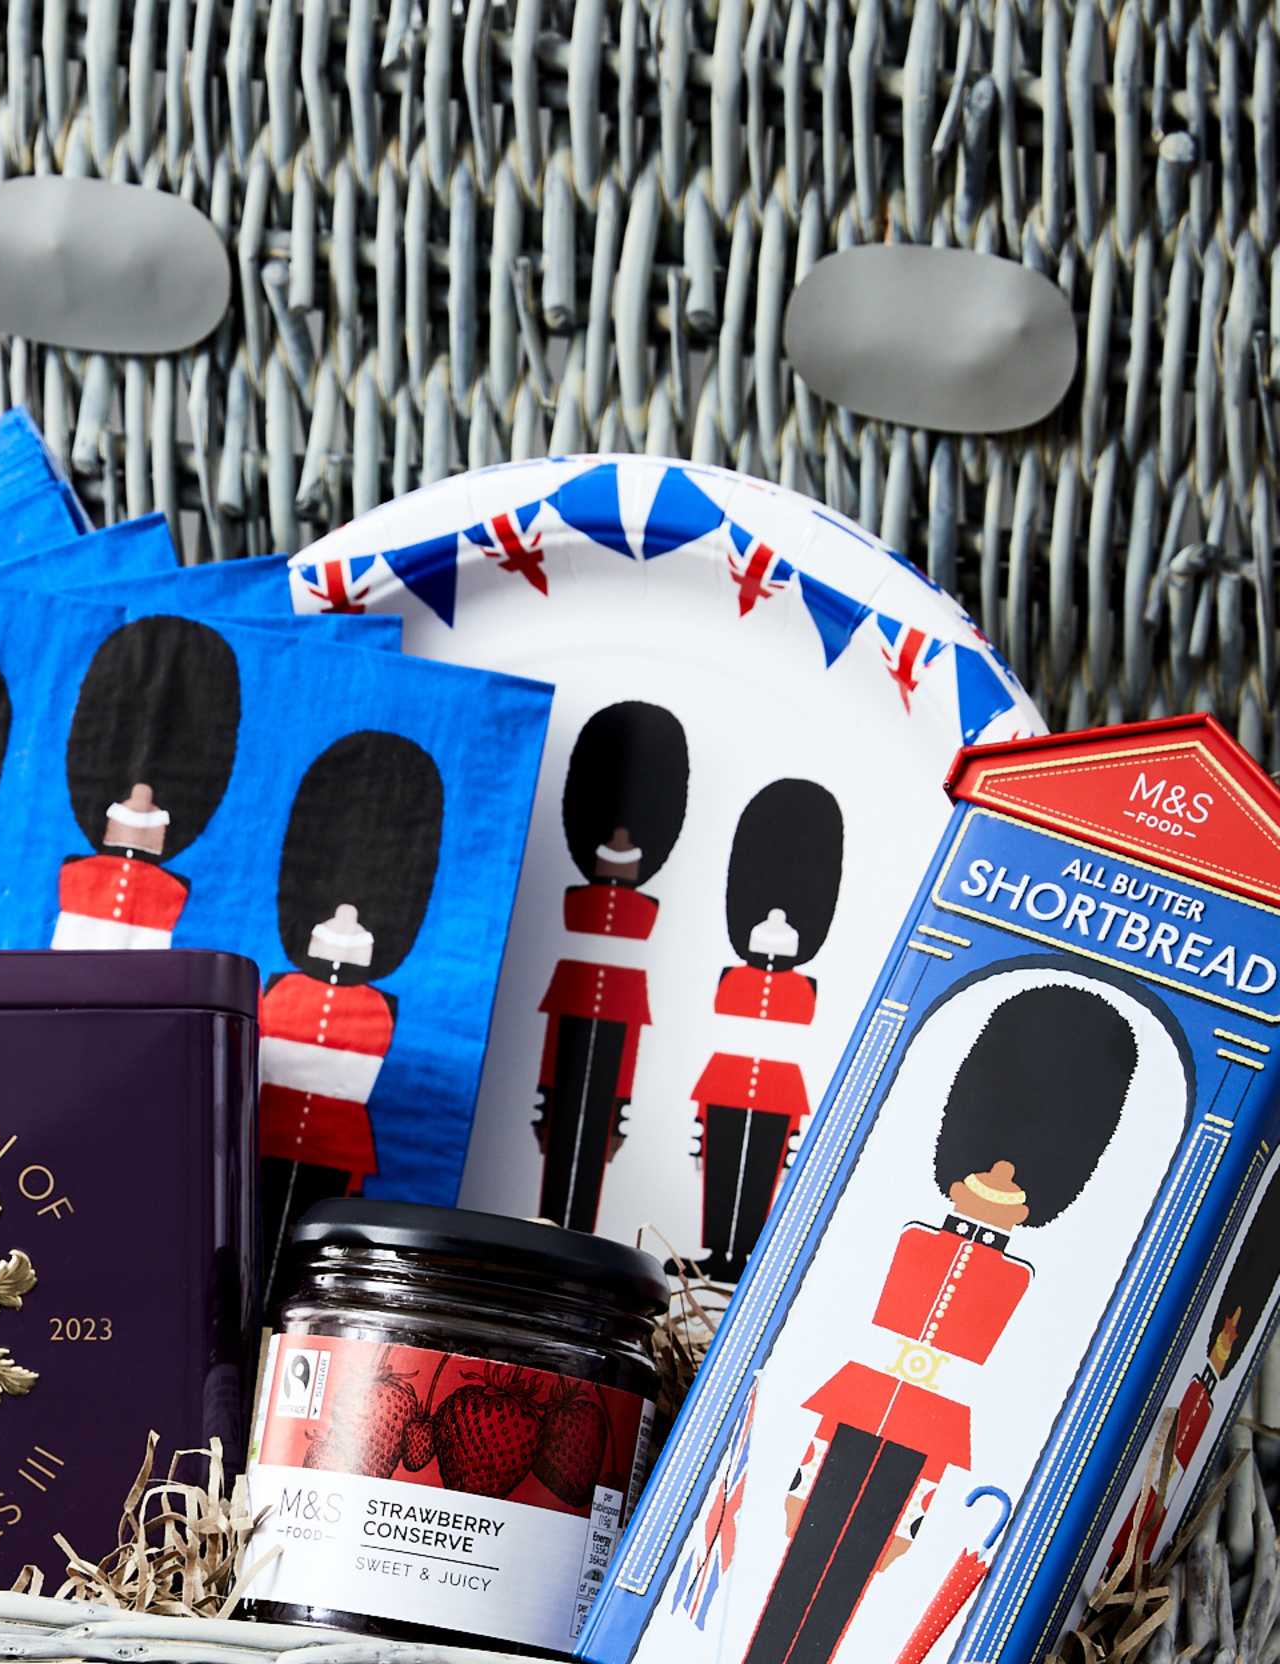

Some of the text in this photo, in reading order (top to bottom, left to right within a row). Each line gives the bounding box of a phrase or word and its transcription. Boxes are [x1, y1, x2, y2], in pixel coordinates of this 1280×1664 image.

[1129, 772, 1214, 824] M&S
[1135, 812, 1183, 837] FOOD
[1061, 858, 1206, 923] ALL BUTTER
[960, 859, 1277, 995] SHORTBREAD
[19, 1165, 75, 1219] OF
[48, 1317, 113, 1341] 2023
[18, 1445, 65, 1492] III
[279, 1487, 344, 1524] M&S
[366, 1499, 505, 1537] STRAWBERRY
[285, 1525, 322, 1541] FOOD
[363, 1520, 475, 1553] CONSERVE
[355, 1556, 492, 1592] SWEET & JUICY
